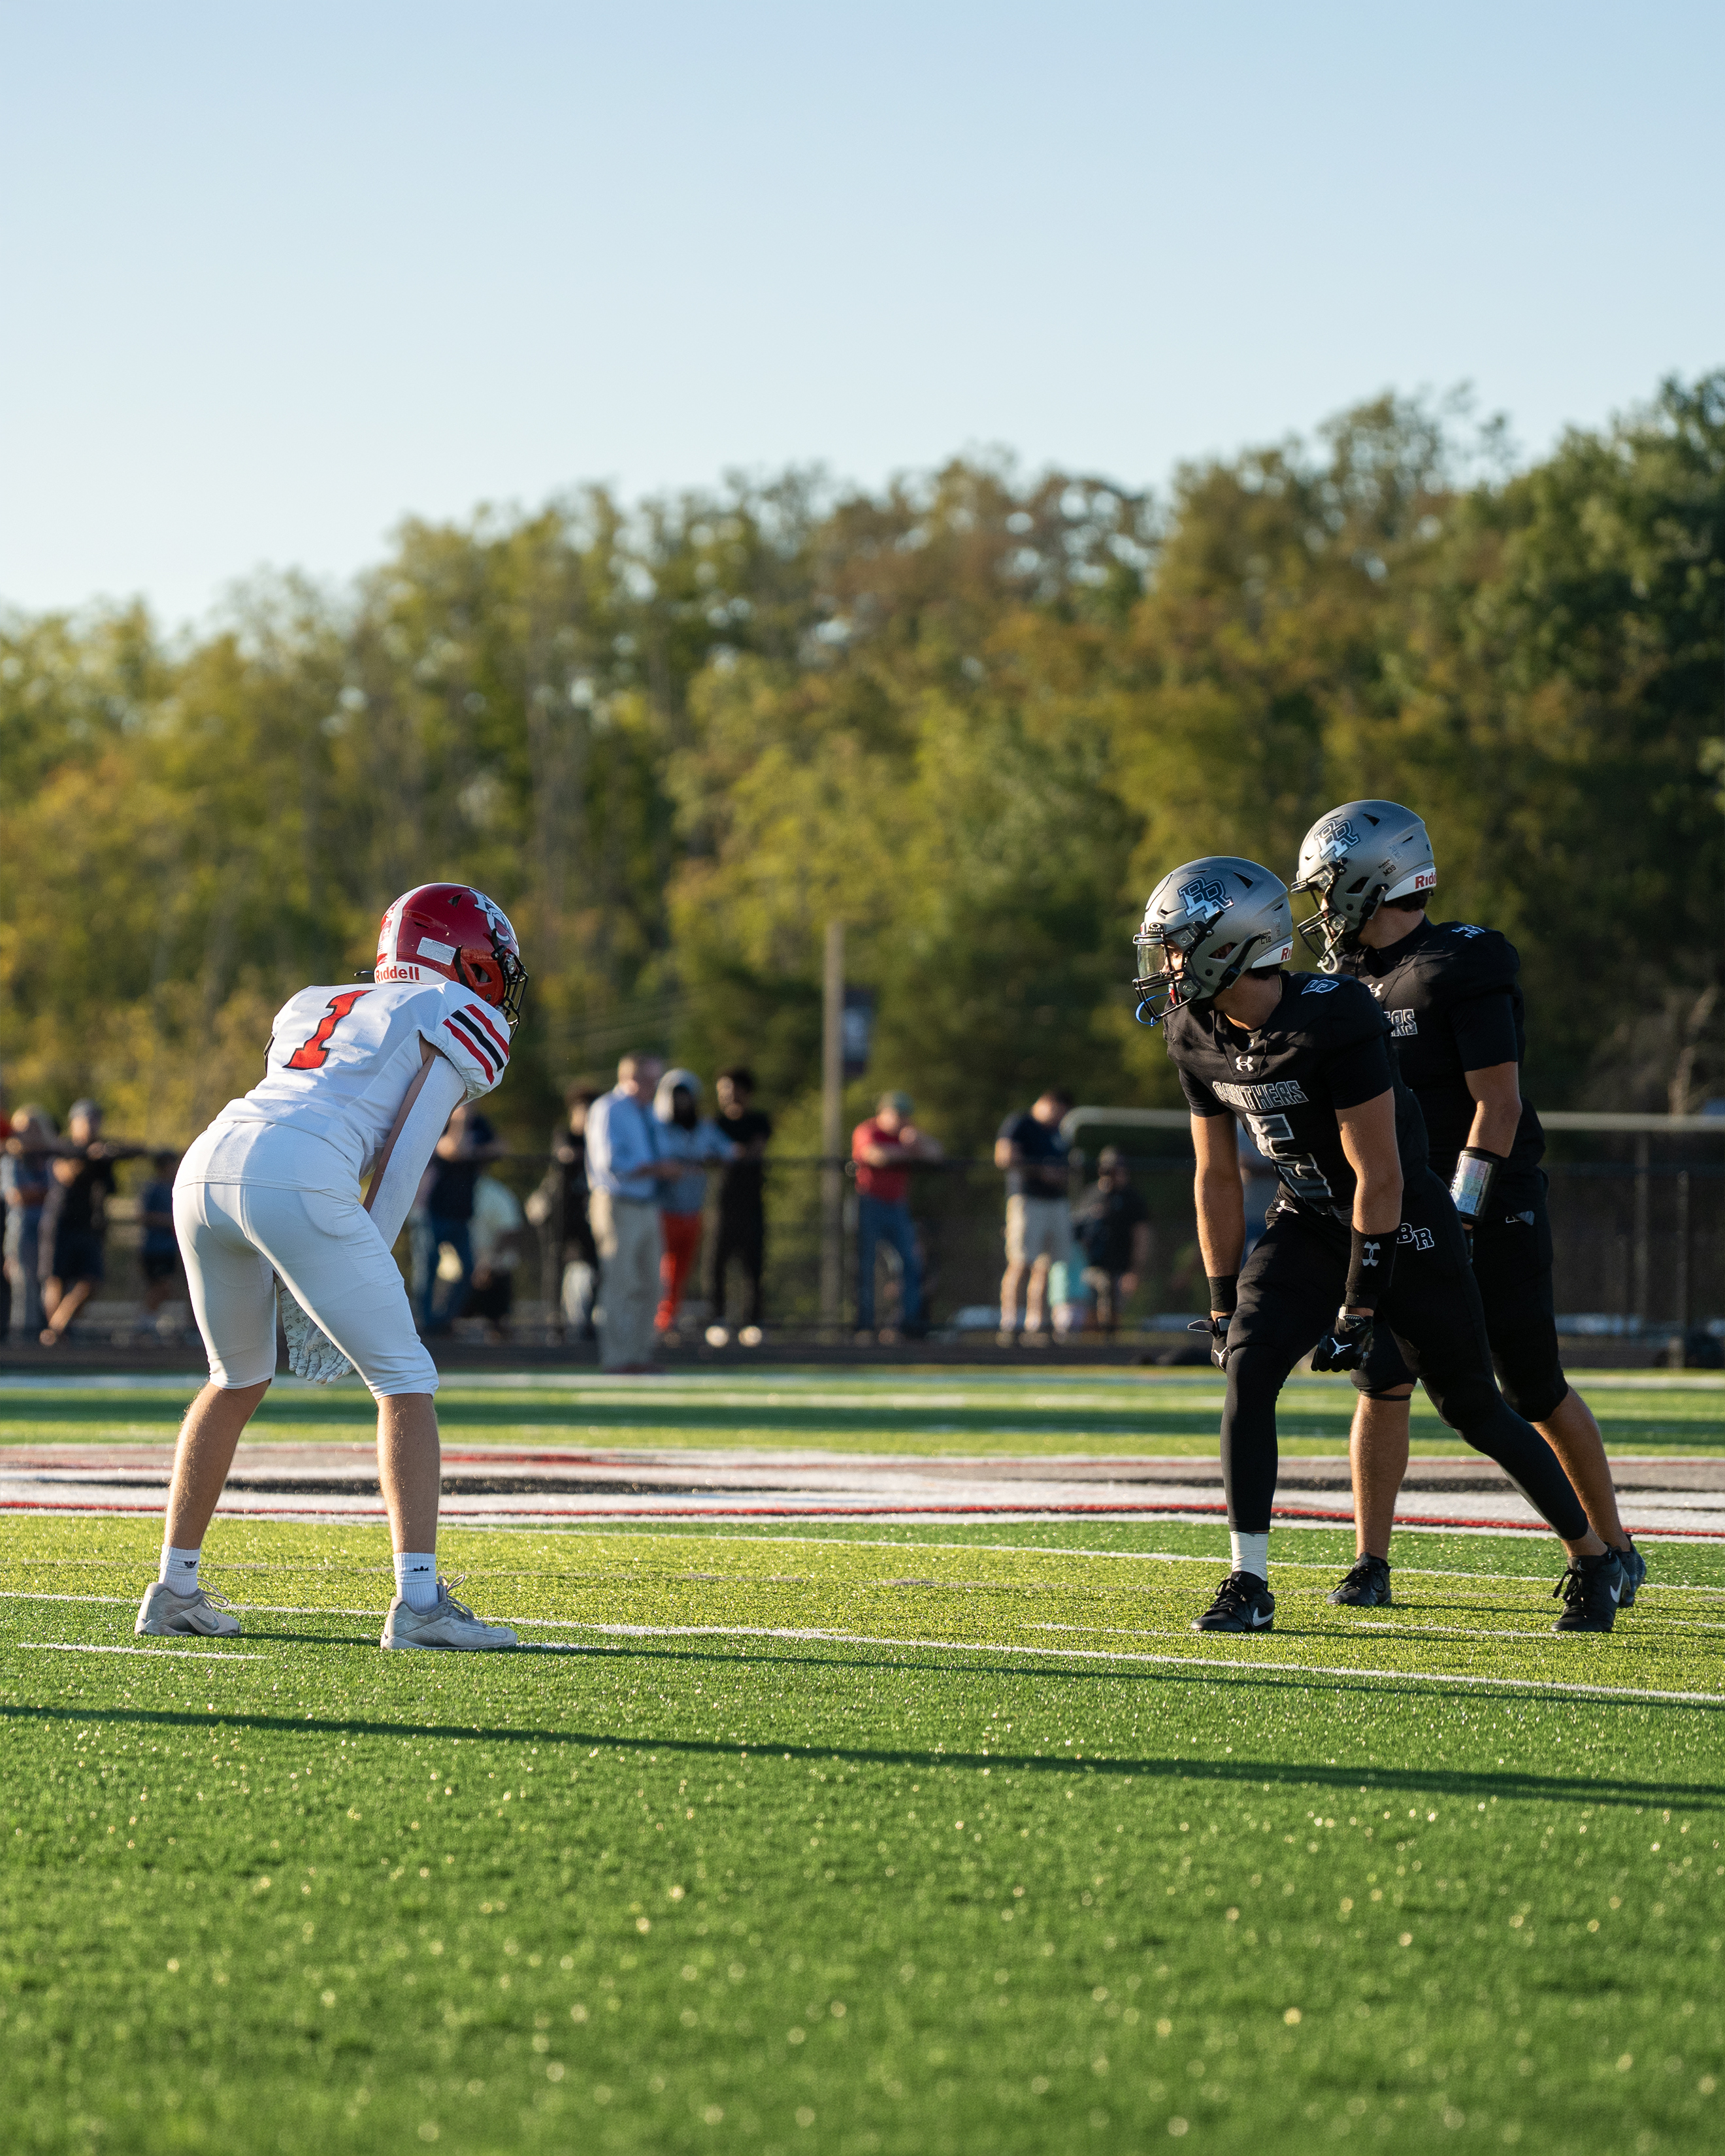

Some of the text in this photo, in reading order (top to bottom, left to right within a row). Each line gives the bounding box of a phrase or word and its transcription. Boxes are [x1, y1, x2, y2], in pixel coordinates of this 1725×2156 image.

[1314, 819, 1361, 860] BR
[1177, 876, 1235, 923] BR
[375, 965, 419, 984] Riddell
[282, 989, 377, 1070] 1
[1212, 1080, 1309, 1110] PANTHERS
[1396, 1223, 1435, 1250] BR
